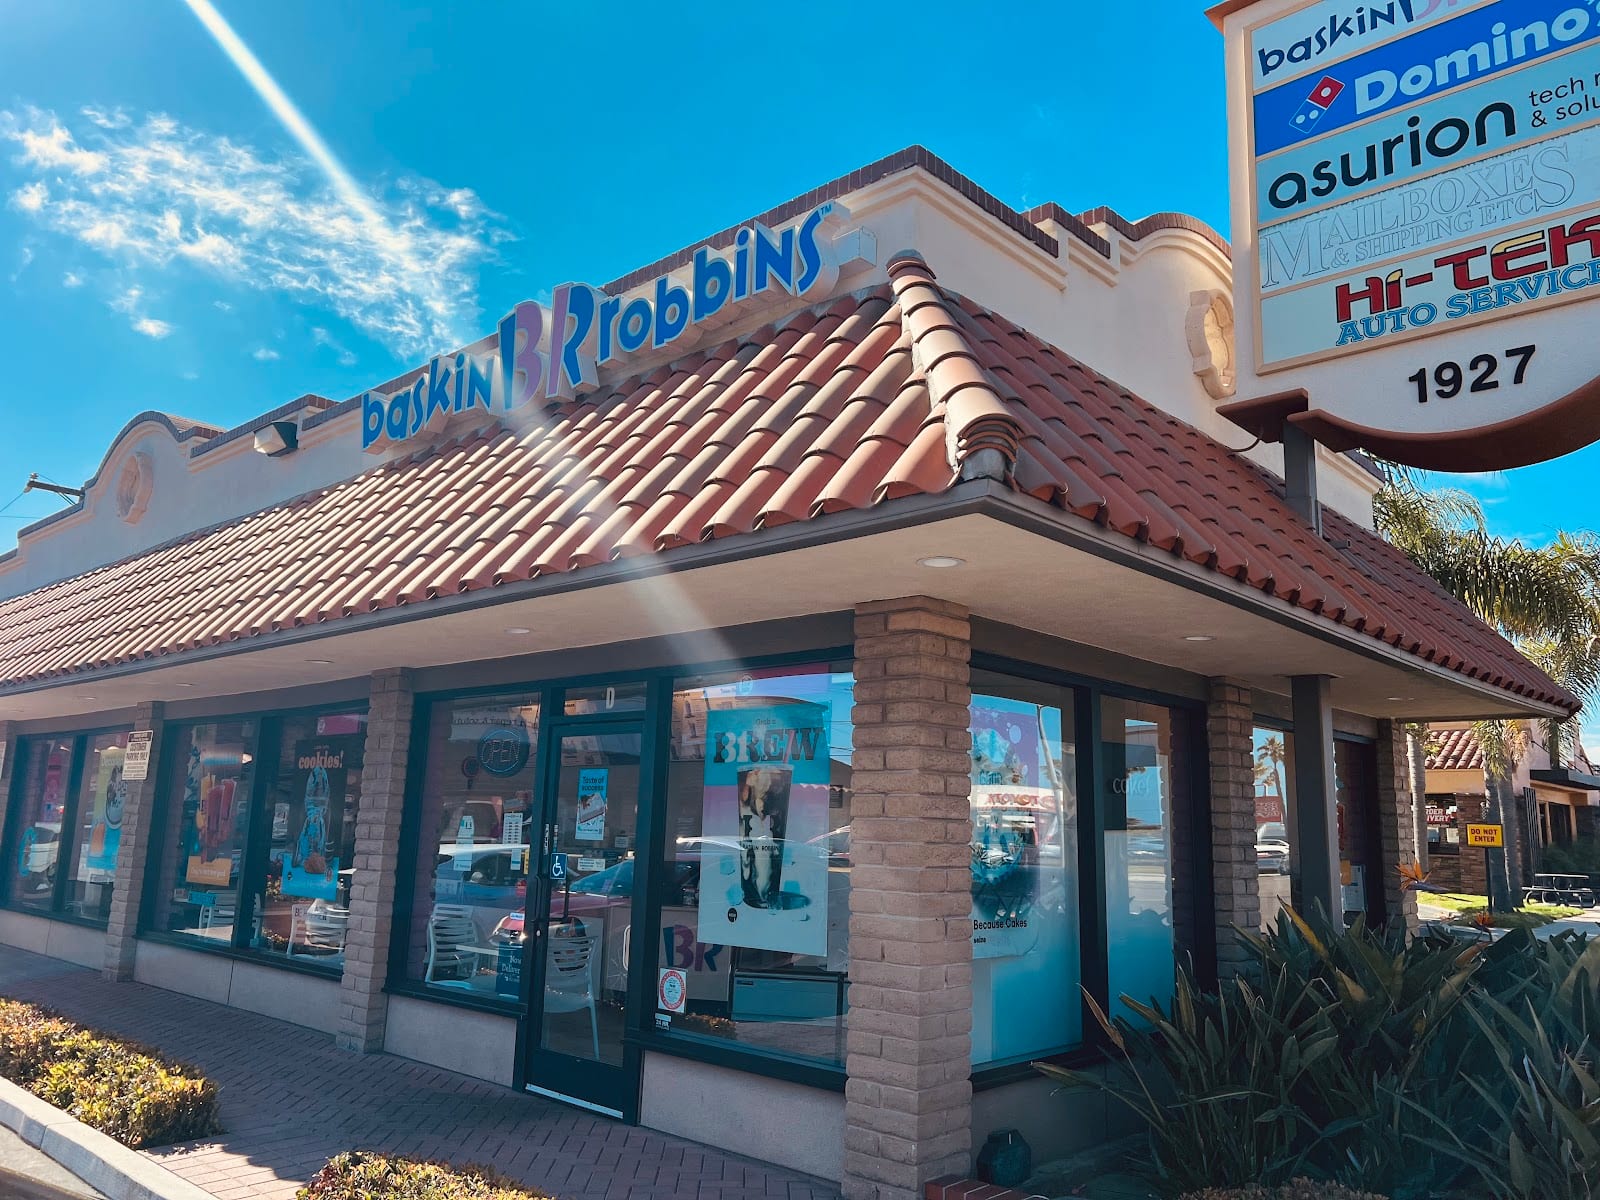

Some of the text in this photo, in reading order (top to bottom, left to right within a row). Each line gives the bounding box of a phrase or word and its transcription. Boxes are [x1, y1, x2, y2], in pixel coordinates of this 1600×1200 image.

[1355, 0, 1600, 115] Domino
[1528, 77, 1584, 107] tech
[1531, 110, 1547, 128] &
[1268, 102, 1516, 209] asurion
[1261, 142, 1575, 288] MAILBOXES
[1355, 208, 1474, 262] SHIPPING
[1336, 303, 1438, 347] AUTO
[1408, 344, 1536, 403] 1927
[606, 687, 616, 710] D
[299, 750, 344, 769] cookies!
[713, 727, 824, 764] BREW
[1474, 835, 1495, 843] ENTER
[973, 918, 1028, 930] Because Cakes
